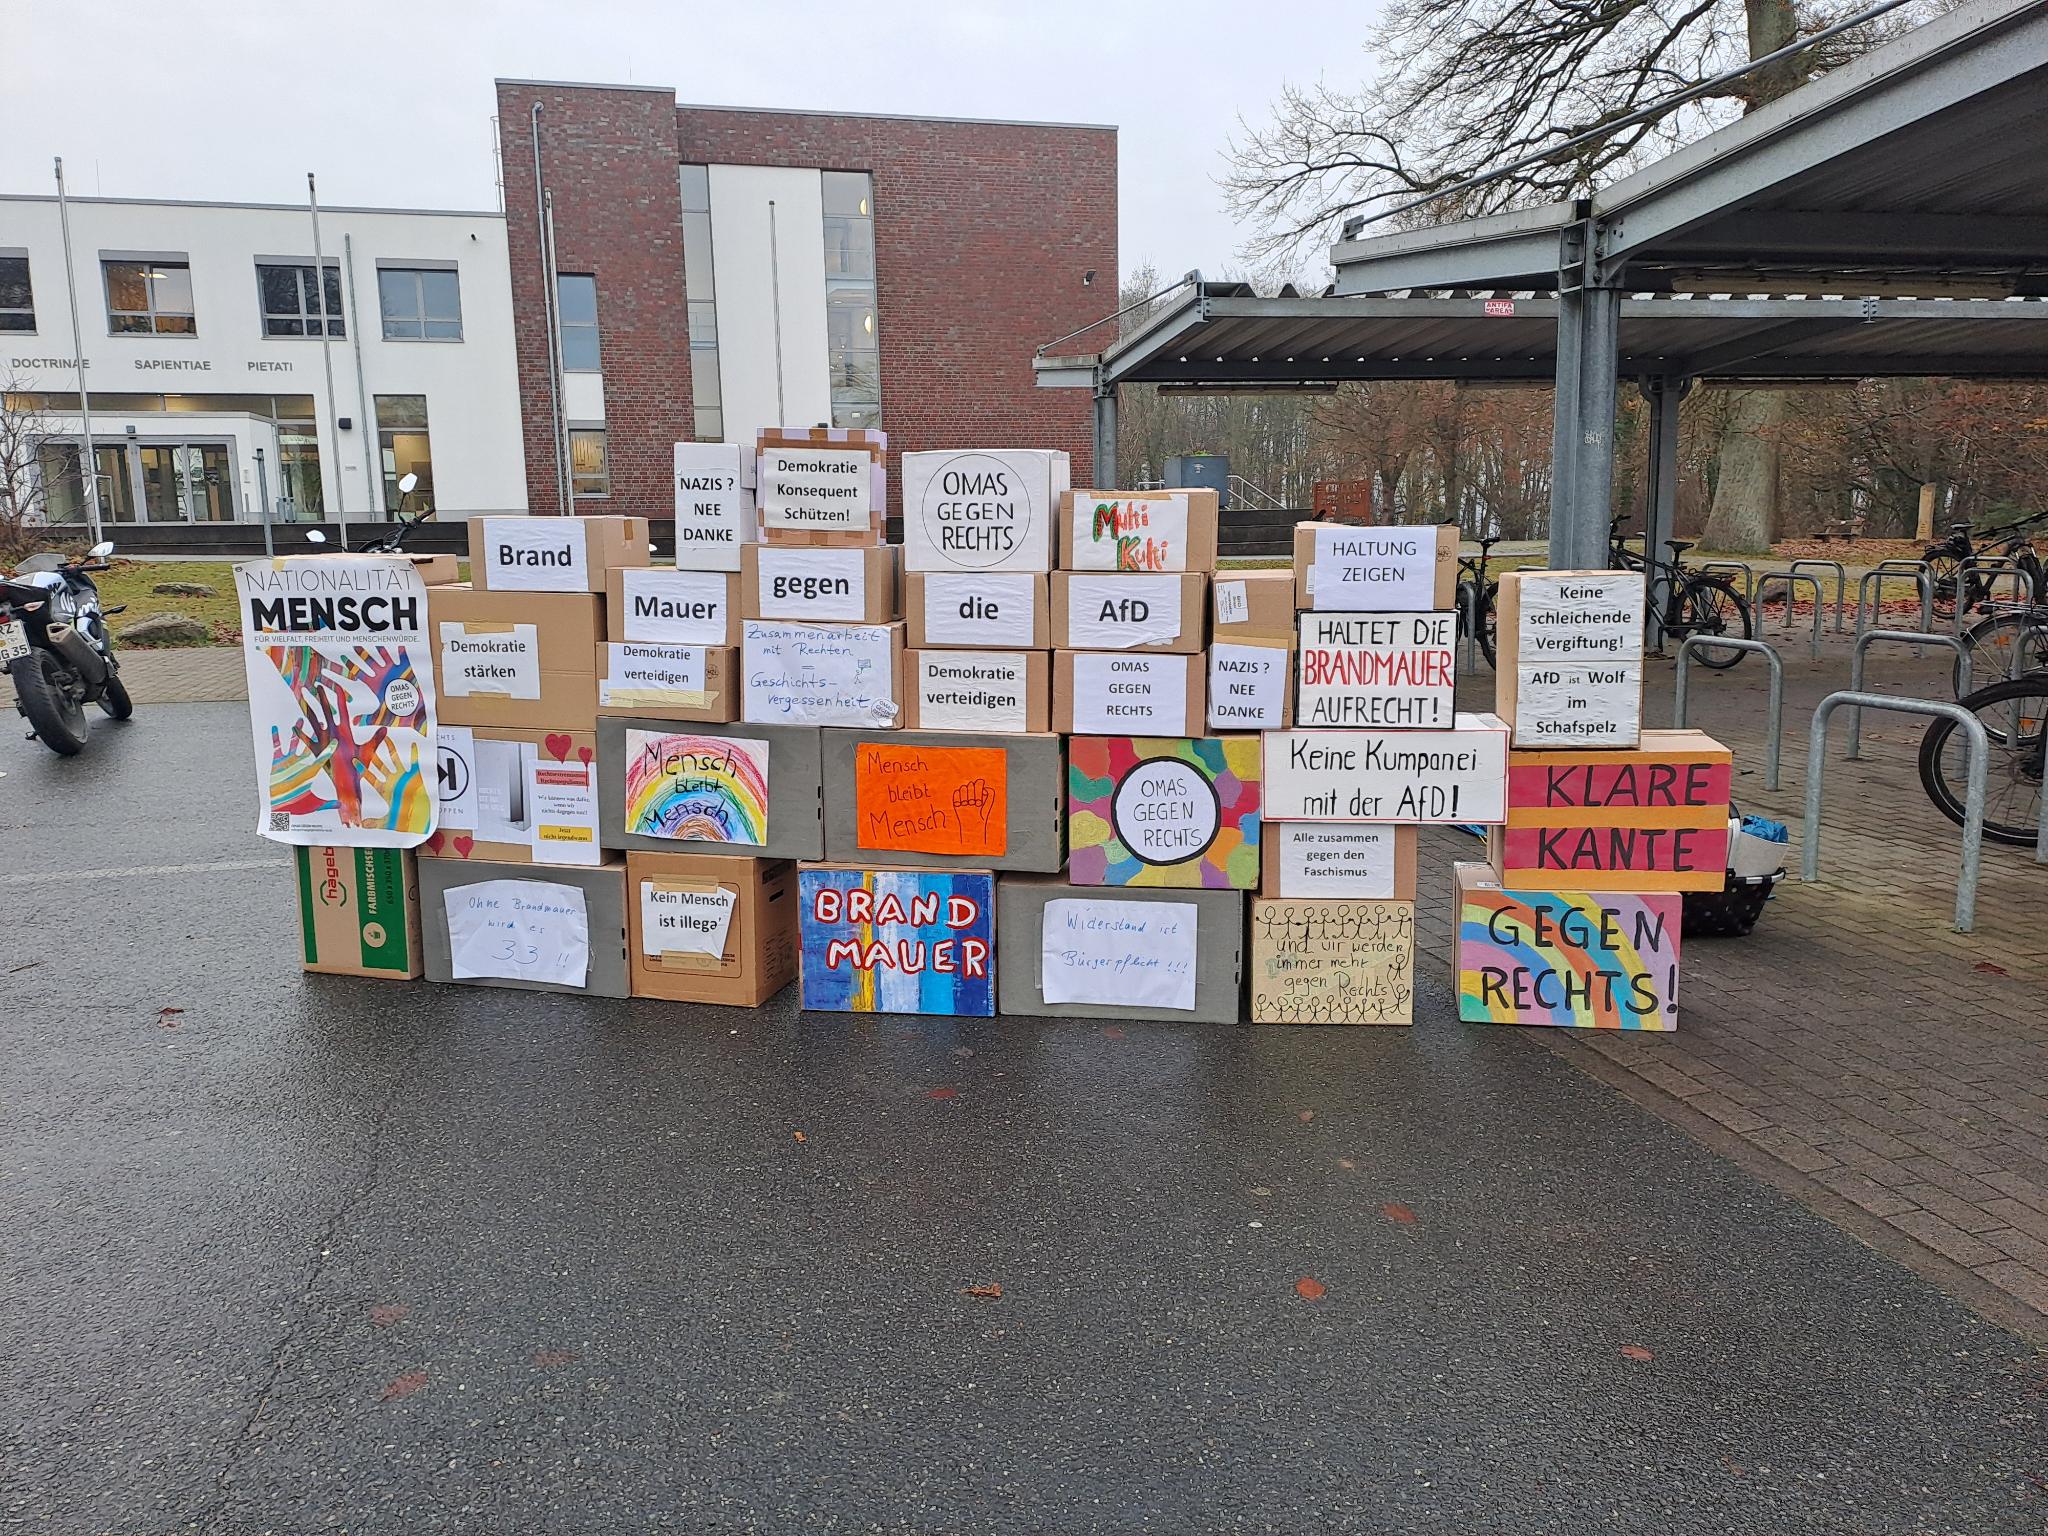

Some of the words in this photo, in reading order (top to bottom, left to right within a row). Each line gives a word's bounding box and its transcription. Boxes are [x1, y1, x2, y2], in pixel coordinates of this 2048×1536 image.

[12, 358, 90, 370] DOCTRINAE
[134, 360, 212, 370] SAPIENTIAE
[248, 361, 293, 372] PIETATI
[778, 459, 858, 474] Demokratie
[680, 477, 722, 491] NAZIS
[727, 478, 734, 491] ?
[777, 483, 858, 499] Konsequent
[943, 471, 1008, 496] OMAS
[694, 503, 722, 516] NEE
[784, 507, 850, 522] Schützen!
[937, 502, 1014, 520] GEGEN
[1092, 501, 1148, 542] Multi
[683, 528, 734, 542] DANKE
[942, 526, 1014, 551] RECHTS
[500, 544, 572, 566] Brand
[1116, 536, 1168, 572] Kulti
[1333, 541, 1417, 556] HALTUNG
[245, 565, 416, 592] NATIONALITÄT
[1342, 567, 1405, 582] ZEIGEN
[773, 575, 849, 600] gegen
[1560, 586, 1604, 599] Keine
[251, 597, 418, 632] MENSCH
[634, 596, 717, 620] Mauer
[959, 596, 999, 620] die
[1098, 599, 1150, 622] AfD
[1530, 610, 1631, 624] schleichende
[748, 624, 880, 642] Zusammenarbeit
[1318, 620, 1400, 646] HALTET
[11, 644, 28, 656] 35
[450, 640, 526, 652] Demokratie
[763, 645, 782, 656] mit
[792, 642, 854, 656] Rechten
[1536, 636, 1624, 652] Vergiftung!
[624, 646, 690, 660] Demokratie
[464, 664, 516, 678] stärken
[928, 664, 1015, 680] Demokratie
[1111, 661, 1150, 672] OMAS
[1218, 660, 1258, 674] NAZIS
[1263, 663, 1270, 674] ?
[1304, 650, 1454, 688] BRANDMAUER
[624, 670, 689, 684] verteidigen
[750, 672, 838, 688] Geschichts-
[1532, 672, 1560, 684] AfD
[1568, 676, 1580, 684] ist
[1588, 671, 1626, 684] Wolf
[390, 684, 410, 692] OMAS
[392, 692, 412, 701] GEGEN
[1108, 684, 1151, 694] GEGEN
[1229, 684, 1256, 696] NEE
[391, 700, 414, 710] RECHTS
[768, 692, 871, 712] vergessenheit
[927, 691, 1016, 709] verteidigen
[1568, 696, 1586, 708] im
[1106, 705, 1152, 716] RECHTS
[1218, 706, 1264, 718] DANKE
[1536, 721, 1616, 736] Schafspelz
[644, 742, 737, 778] Mensch
[868, 752, 928, 774] Mensch
[1291, 738, 1356, 771] Keine
[1366, 739, 1477, 778] Kumpanei
[888, 784, 931, 803] bleibt
[1140, 778, 1188, 798] OMAS
[1546, 763, 1712, 808] KLARE
[1133, 801, 1194, 822] GEGEN
[1304, 788, 1338, 816] mit
[1350, 788, 1383, 816] der
[1396, 785, 1460, 822] AfD!
[644, 799, 728, 834] Mensch
[870, 804, 946, 840] Mensch
[1144, 828, 1203, 848] RECHTS
[1293, 833, 1315, 842] Alle
[1318, 834, 1379, 843] zusammen
[1306, 852, 1340, 862] gegen
[1343, 850, 1365, 860] den
[1538, 827, 1699, 872] KANTE
[1304, 867, 1368, 877] Faschismus
[468, 896, 501, 909] Ohne
[512, 898, 576, 916] Brandmauer
[650, 892, 677, 904] Kein
[681, 892, 728, 907] Mensch
[814, 888, 980, 930] BRAND
[488, 920, 516, 929] wird
[529, 925, 545, 934] es
[659, 914, 676, 928] ist
[1067, 908, 1147, 933] Widerstand
[1160, 922, 1178, 934] ist
[1488, 905, 1664, 952] GEGEN
[1276, 932, 1314, 954] und
[1352, 932, 1403, 952] werden
[492, 940, 538, 964] 33
[826, 938, 990, 980] MAUER
[1061, 950, 1160, 974] Bürgerpflicht
[1276, 955, 1322, 970] immer
[1284, 976, 1328, 996] gegen
[1333, 971, 1388, 998] Rechts
[1480, 964, 1678, 1015] RECHTS!
